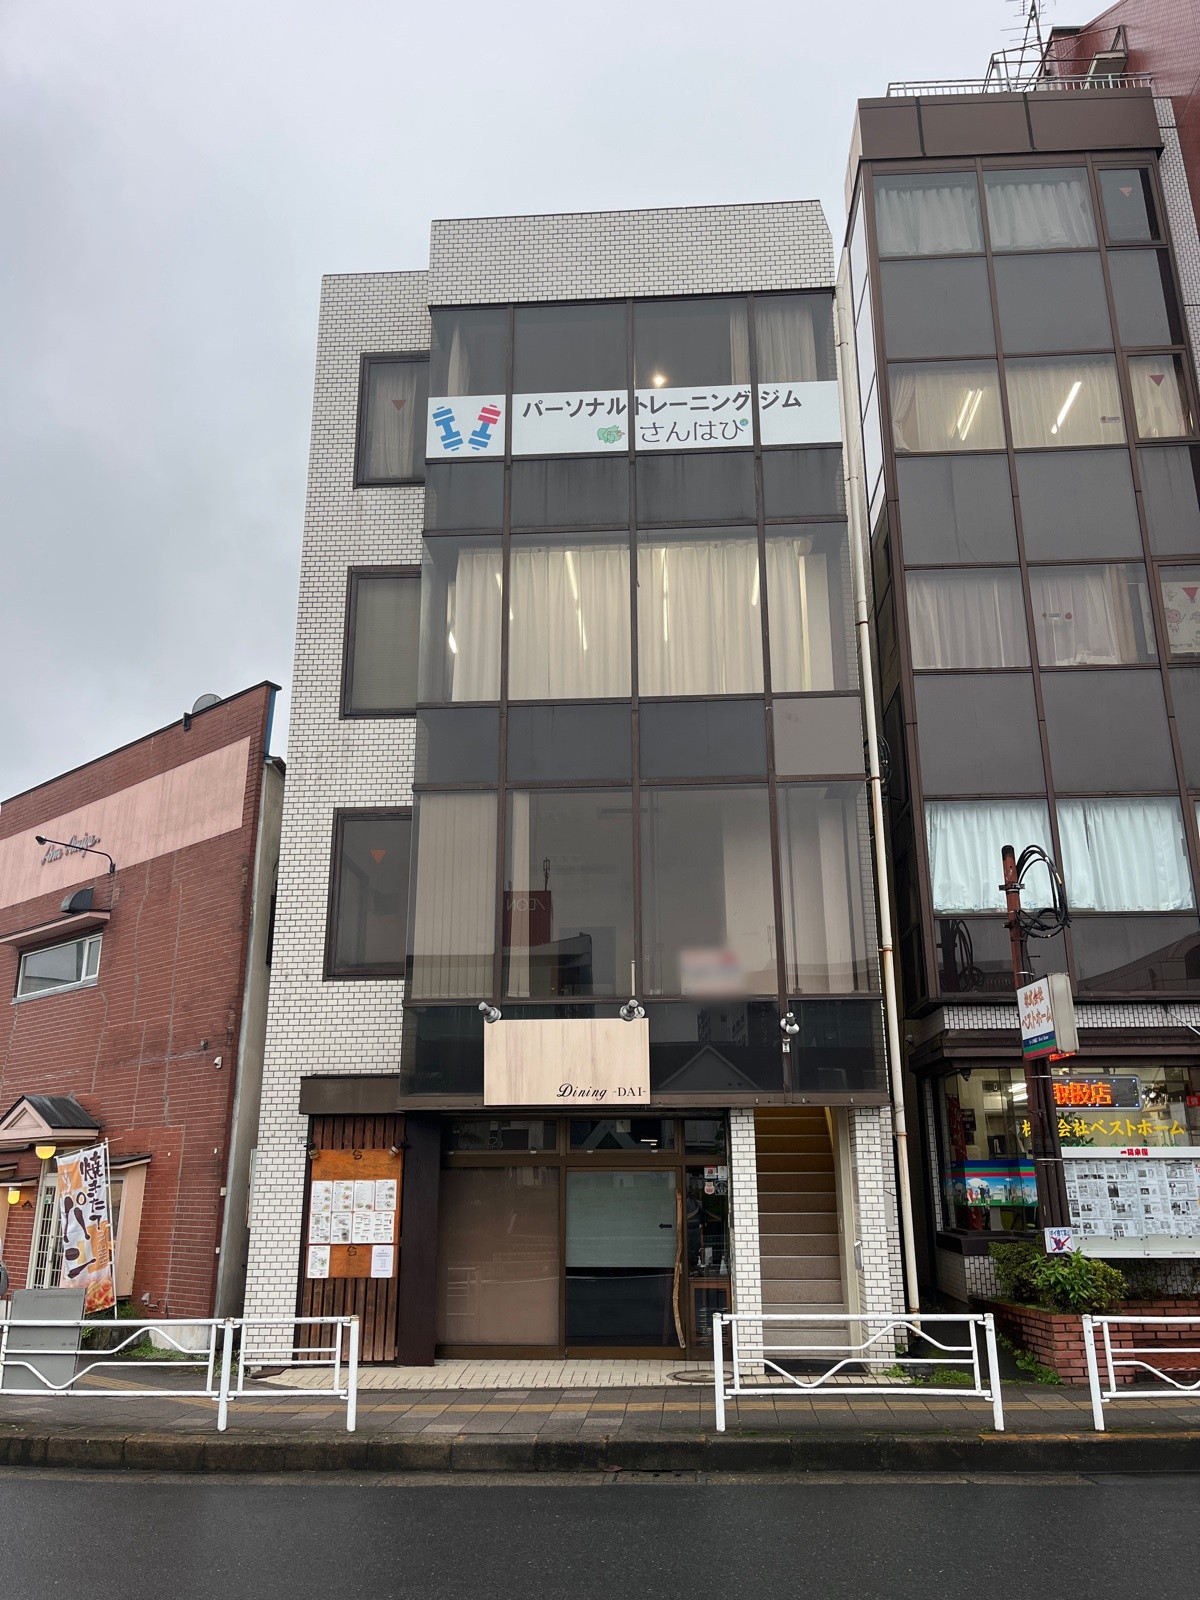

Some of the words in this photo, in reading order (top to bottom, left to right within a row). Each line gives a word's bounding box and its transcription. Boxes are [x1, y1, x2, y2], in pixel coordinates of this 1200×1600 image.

[1022, 1005, 1053, 1030] ベストホーム
[557, 1082, 608, 1101] Dining
[80, 1151, 106, 1230] 焼きたて
[63, 1191, 97, 1279] パン
